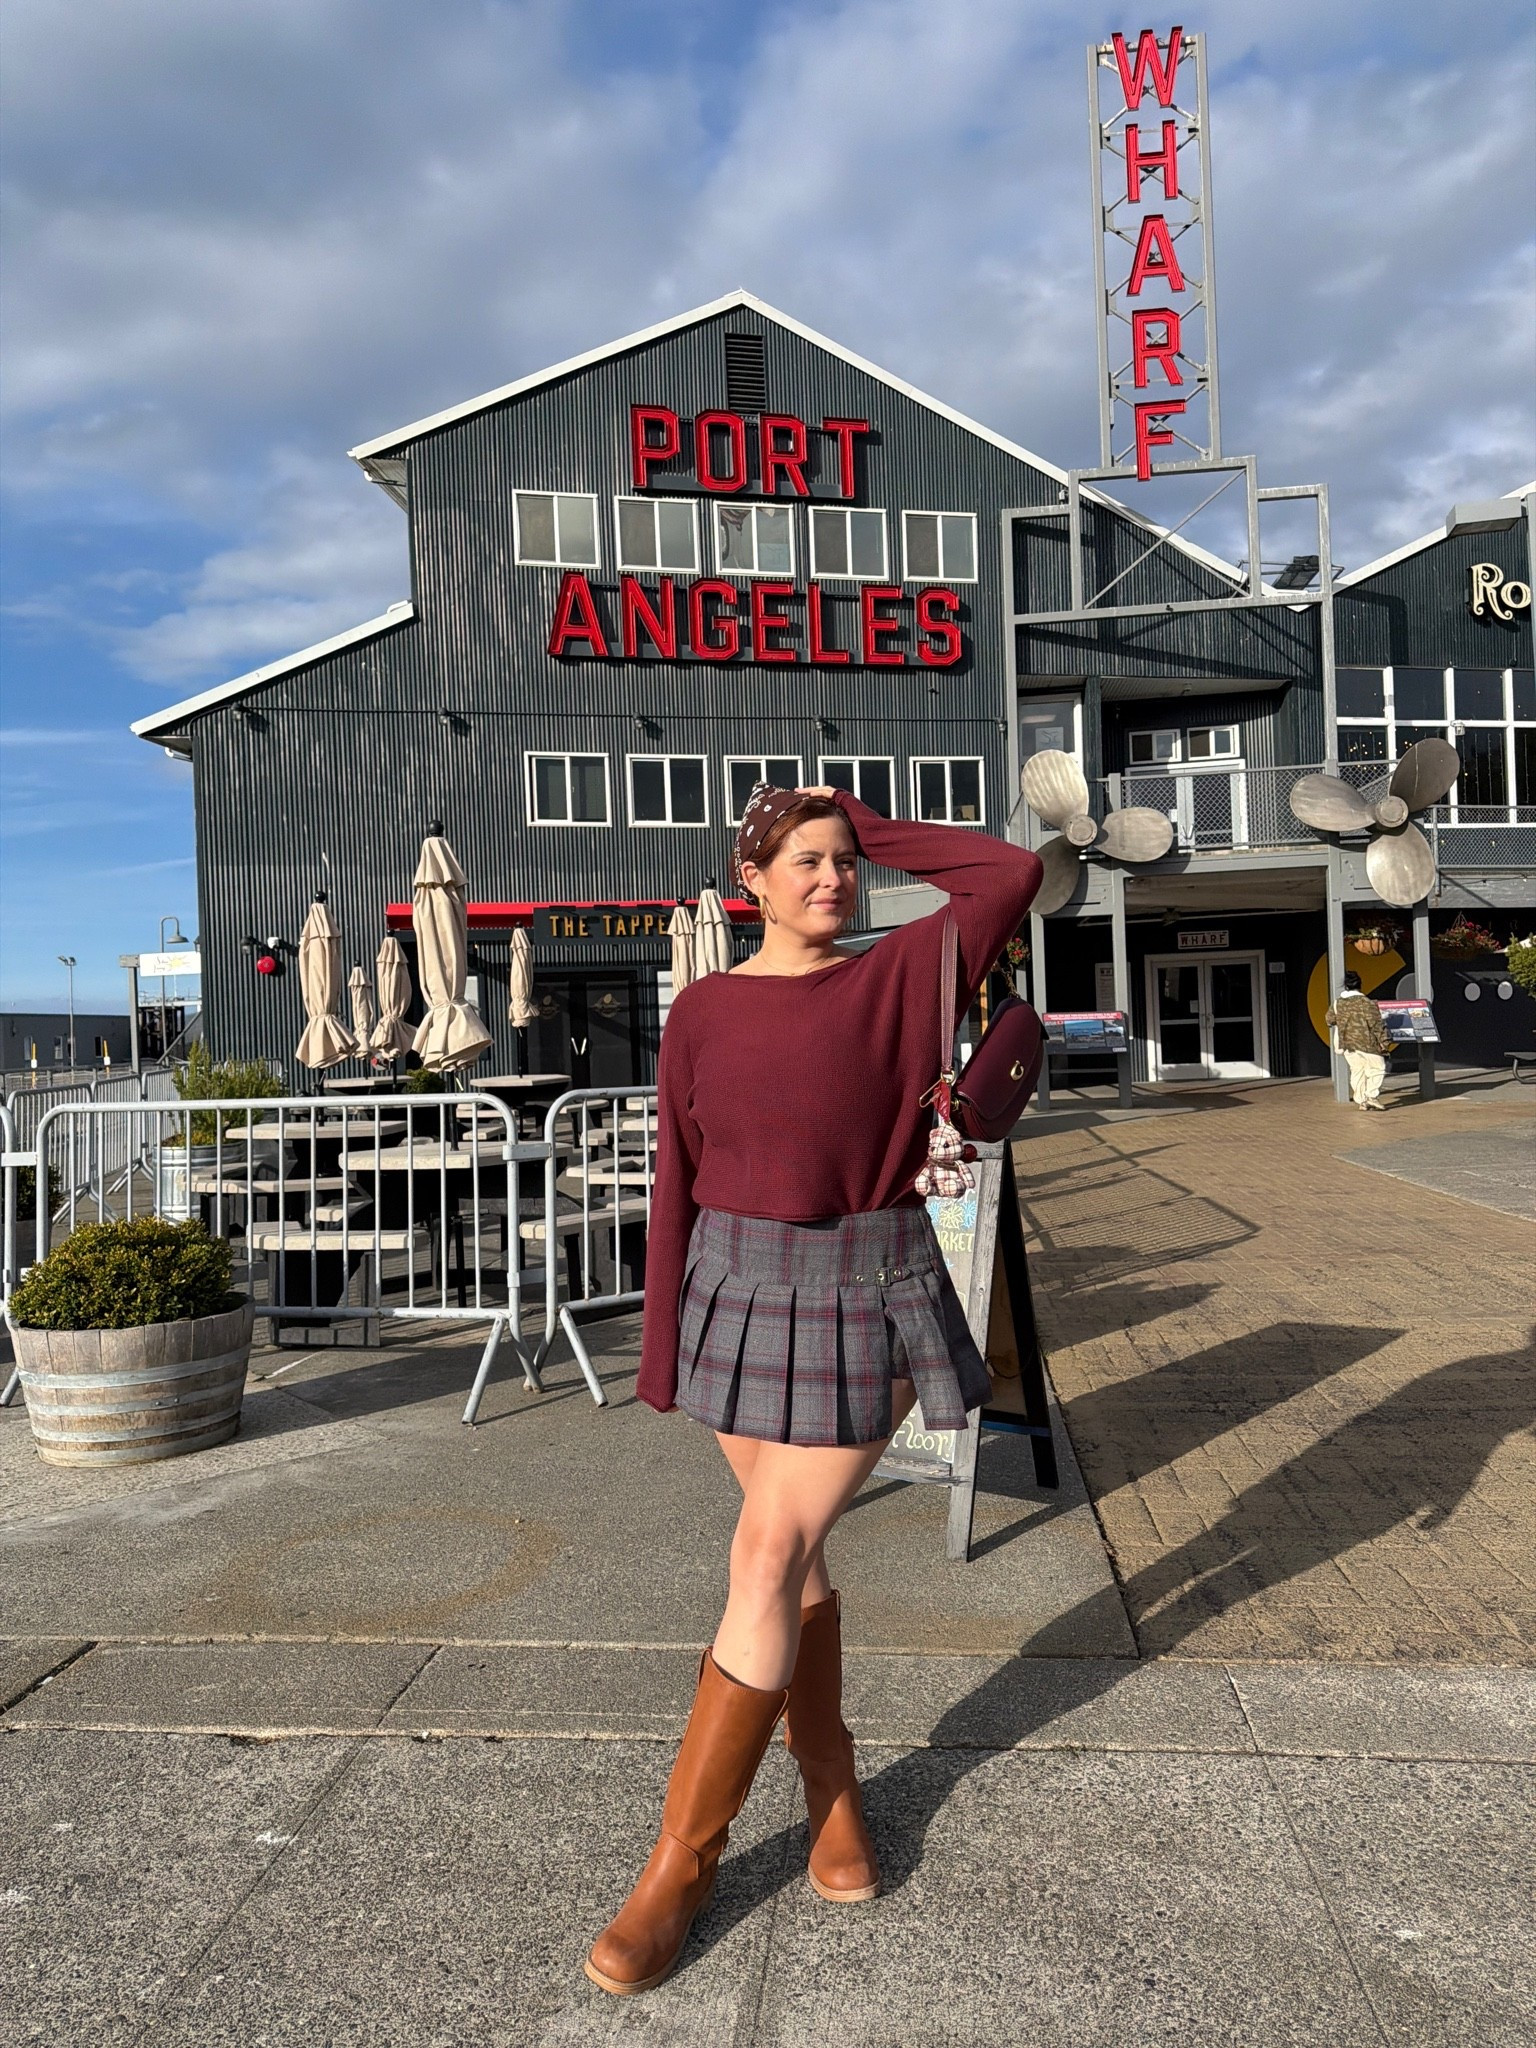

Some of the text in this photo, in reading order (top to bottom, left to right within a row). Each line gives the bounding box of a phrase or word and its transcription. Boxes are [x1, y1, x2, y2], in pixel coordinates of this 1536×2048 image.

[1111, 25, 1187, 482] WHARF
[631, 403, 870, 499] PORT
[547, 570, 963, 667] ANGELES
[1470, 562, 1532, 620] Ro
[549, 914, 589, 937] THE
[1180, 933, 1226, 945] WHARF
